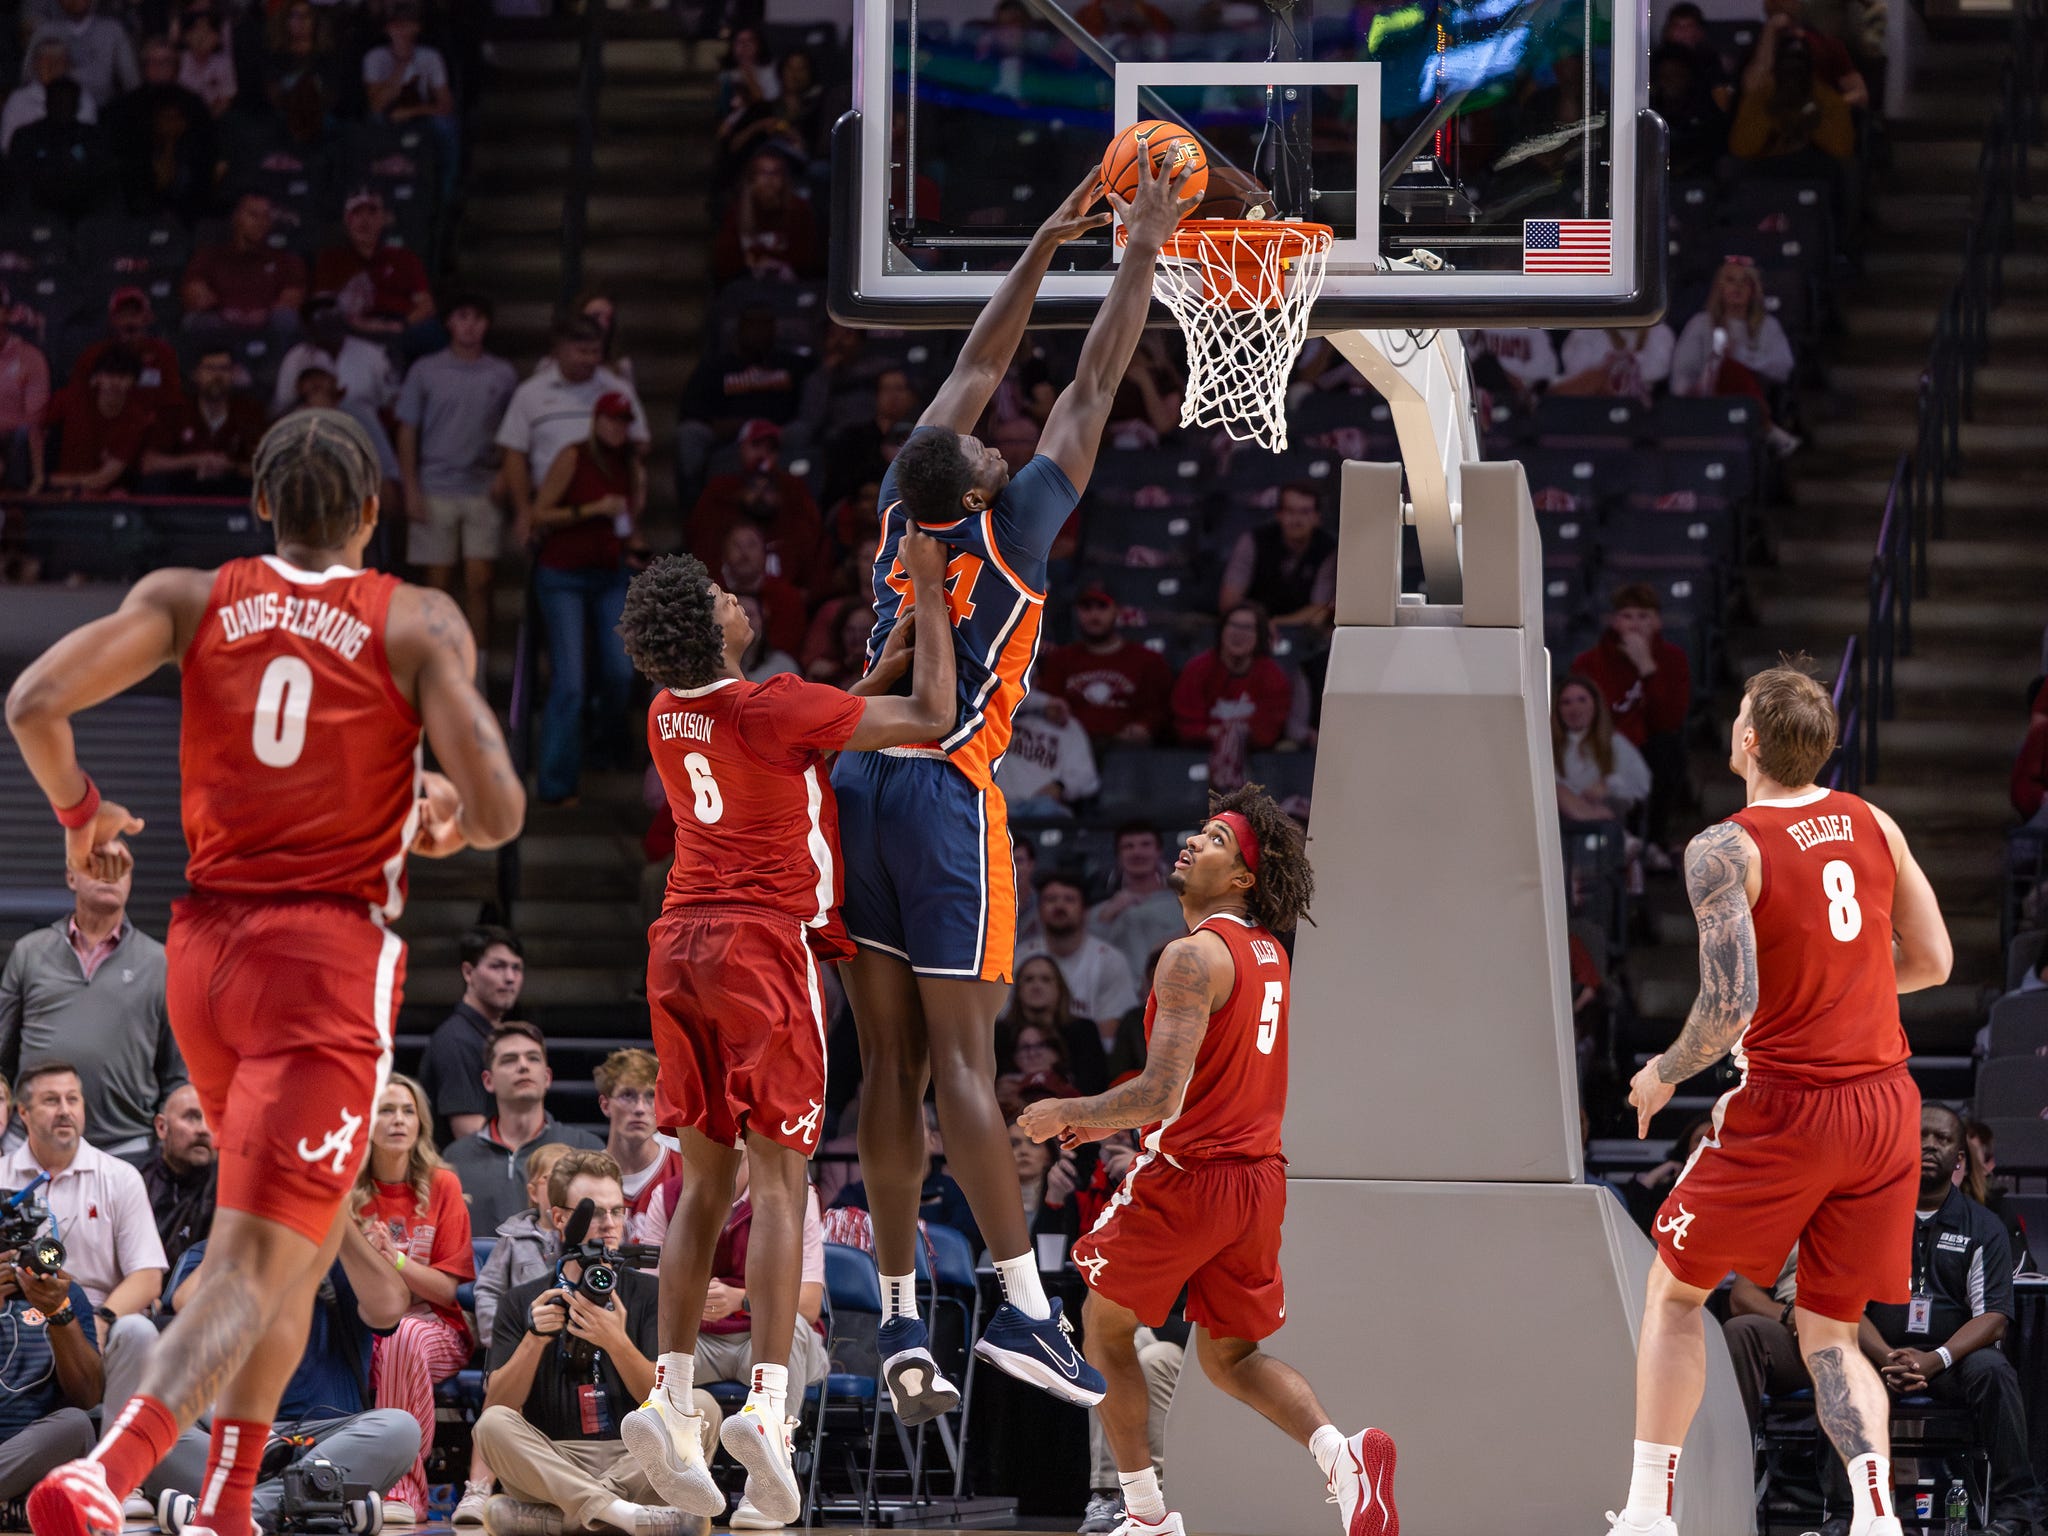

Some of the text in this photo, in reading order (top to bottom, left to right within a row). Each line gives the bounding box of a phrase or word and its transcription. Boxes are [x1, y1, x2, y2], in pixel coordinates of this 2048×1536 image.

[218, 592, 372, 662] DAVIS-FLEMING
[252, 655, 313, 768] 0
[657, 712, 715, 744] JEMISON
[683, 752, 723, 824] 6
[1786, 815, 1854, 851] FIELDER
[1822, 860, 1862, 942] 8
[1256, 981, 1283, 1054] 5
[1940, 1232, 1972, 1246] BEST
